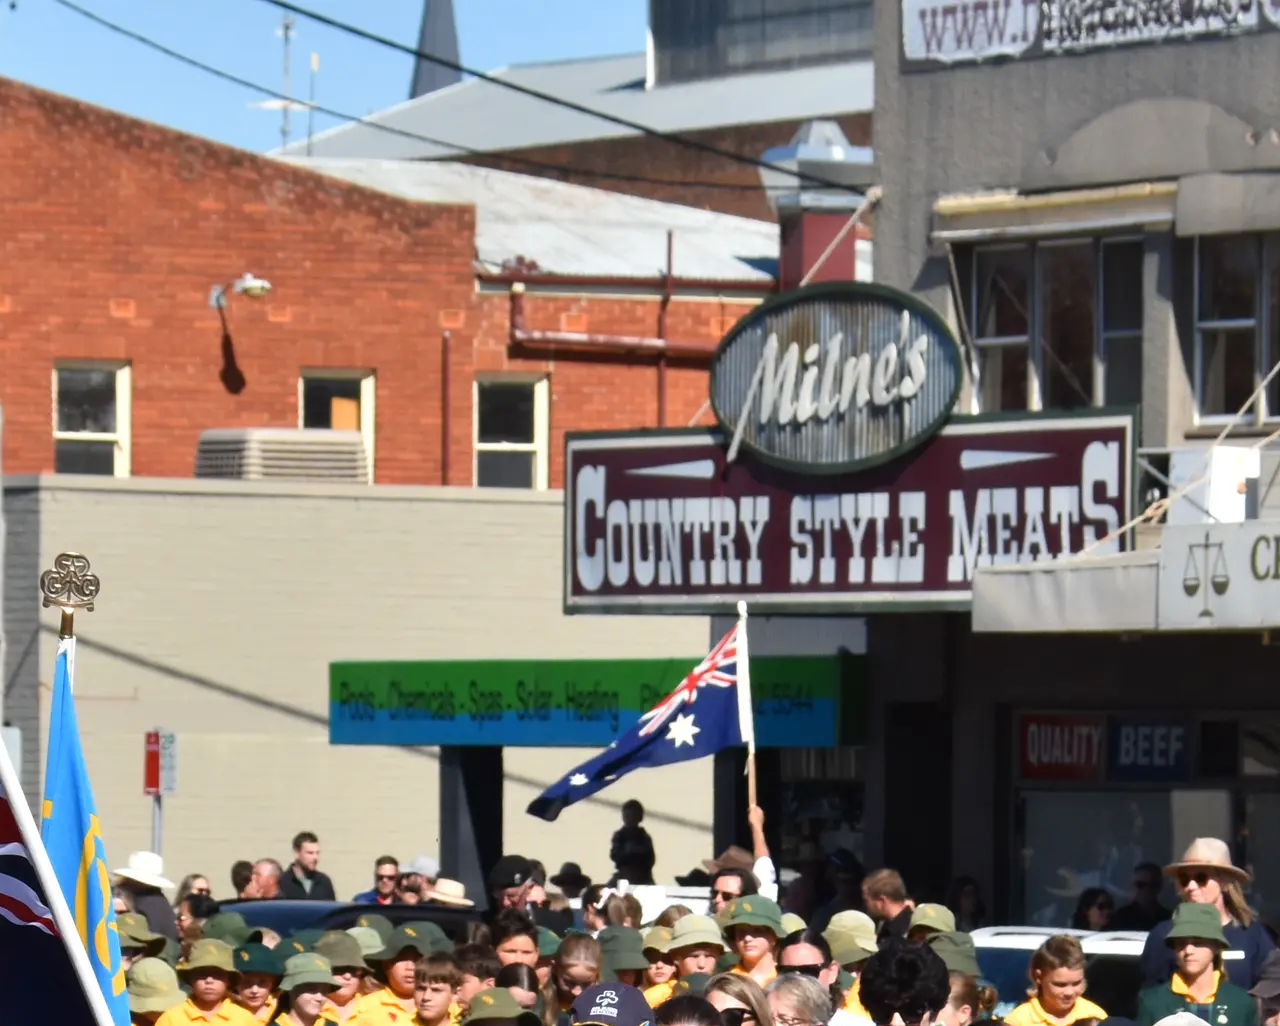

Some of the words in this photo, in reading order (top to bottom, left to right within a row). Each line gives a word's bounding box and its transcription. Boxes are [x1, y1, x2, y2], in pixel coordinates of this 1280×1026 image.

[726, 309, 928, 463] Milne's
[576, 464, 770, 592] COUNTRY
[789, 491, 926, 585] STYLE
[947, 441, 1119, 583] MEATS
[338, 680, 375, 722] Pools
[387, 680, 456, 722] Chemicals
[468, 680, 504, 732] Spas
[516, 679, 553, 722] Solar
[565, 680, 620, 733] Heating
[1027, 723, 1101, 767] QUALITY
[1119, 724, 1184, 766] BEEF
